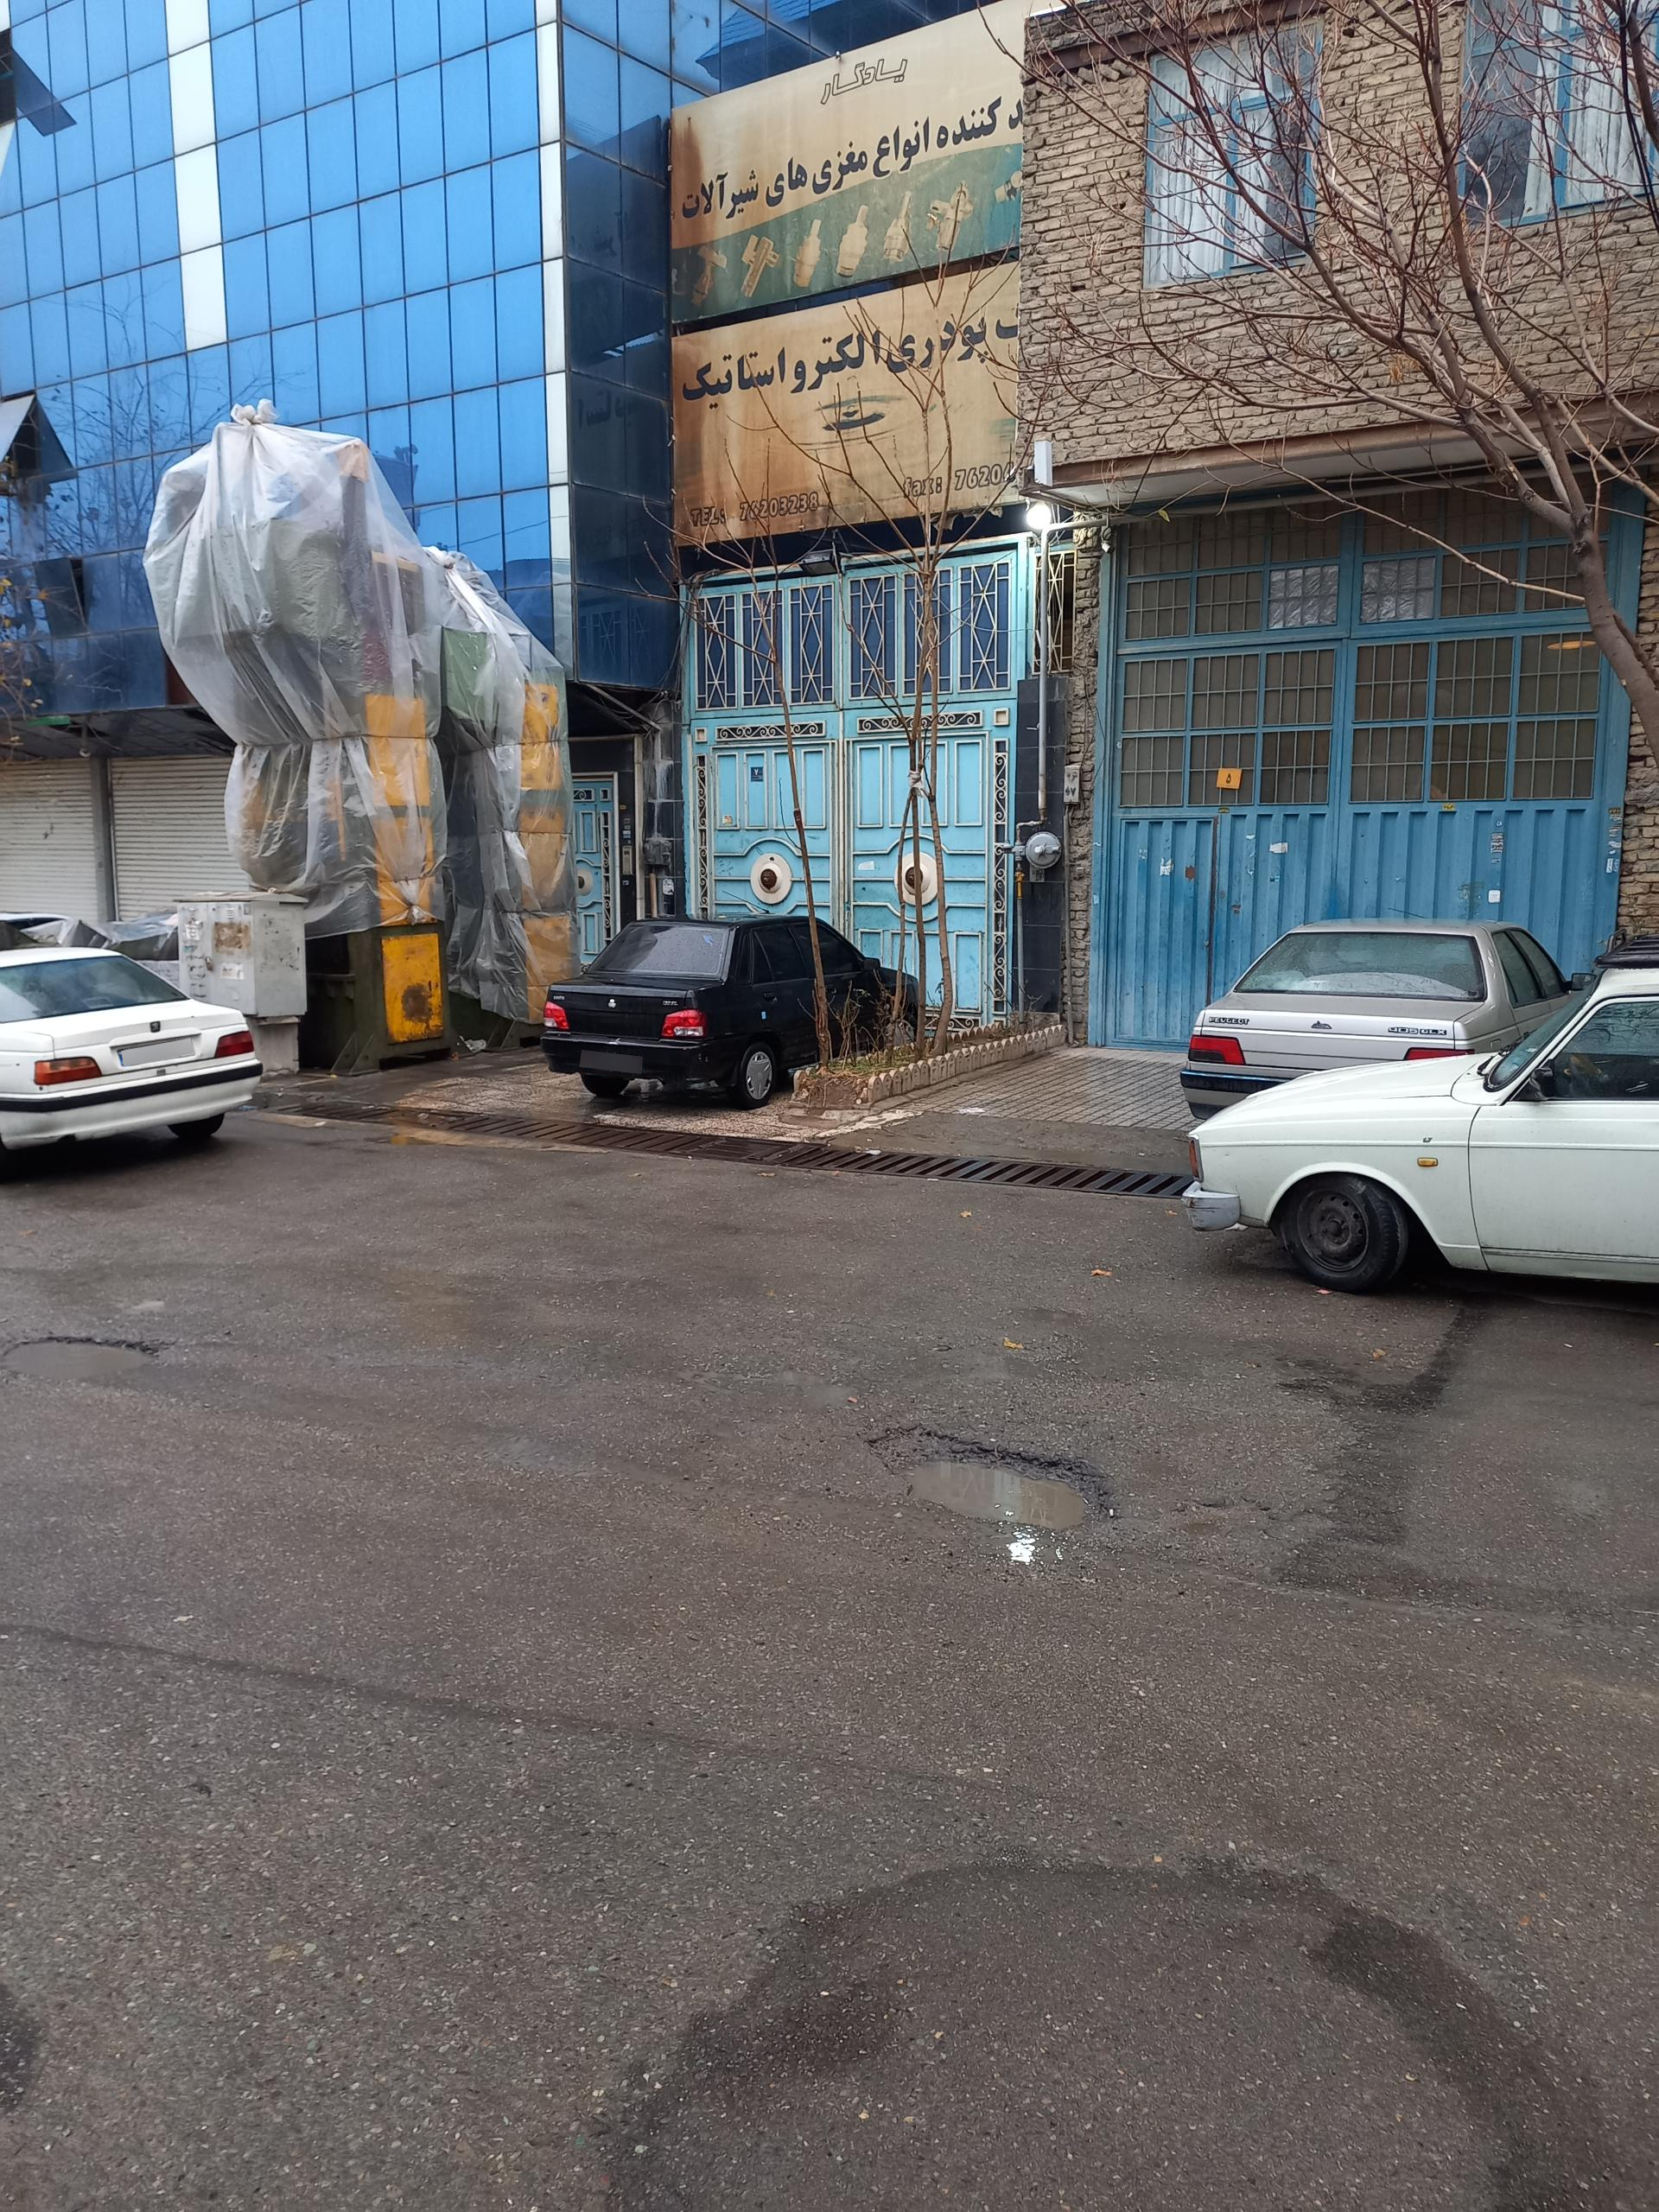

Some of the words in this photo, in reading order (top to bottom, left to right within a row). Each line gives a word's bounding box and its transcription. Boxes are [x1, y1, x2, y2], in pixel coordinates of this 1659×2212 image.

[820, 58, 908, 105] یادگار
[873, 116, 930, 177] انواع
[937, 96, 1001, 149] کننده
[766, 156, 808, 207] های
[812, 141, 868, 194] مغزی
[887, 316, 988, 373] پودری
[739, 491, 819, 522] 76203238
[1209, 1016, 1250, 1026] PEUGEOT
[1388, 1027, 1418, 1035] 405
